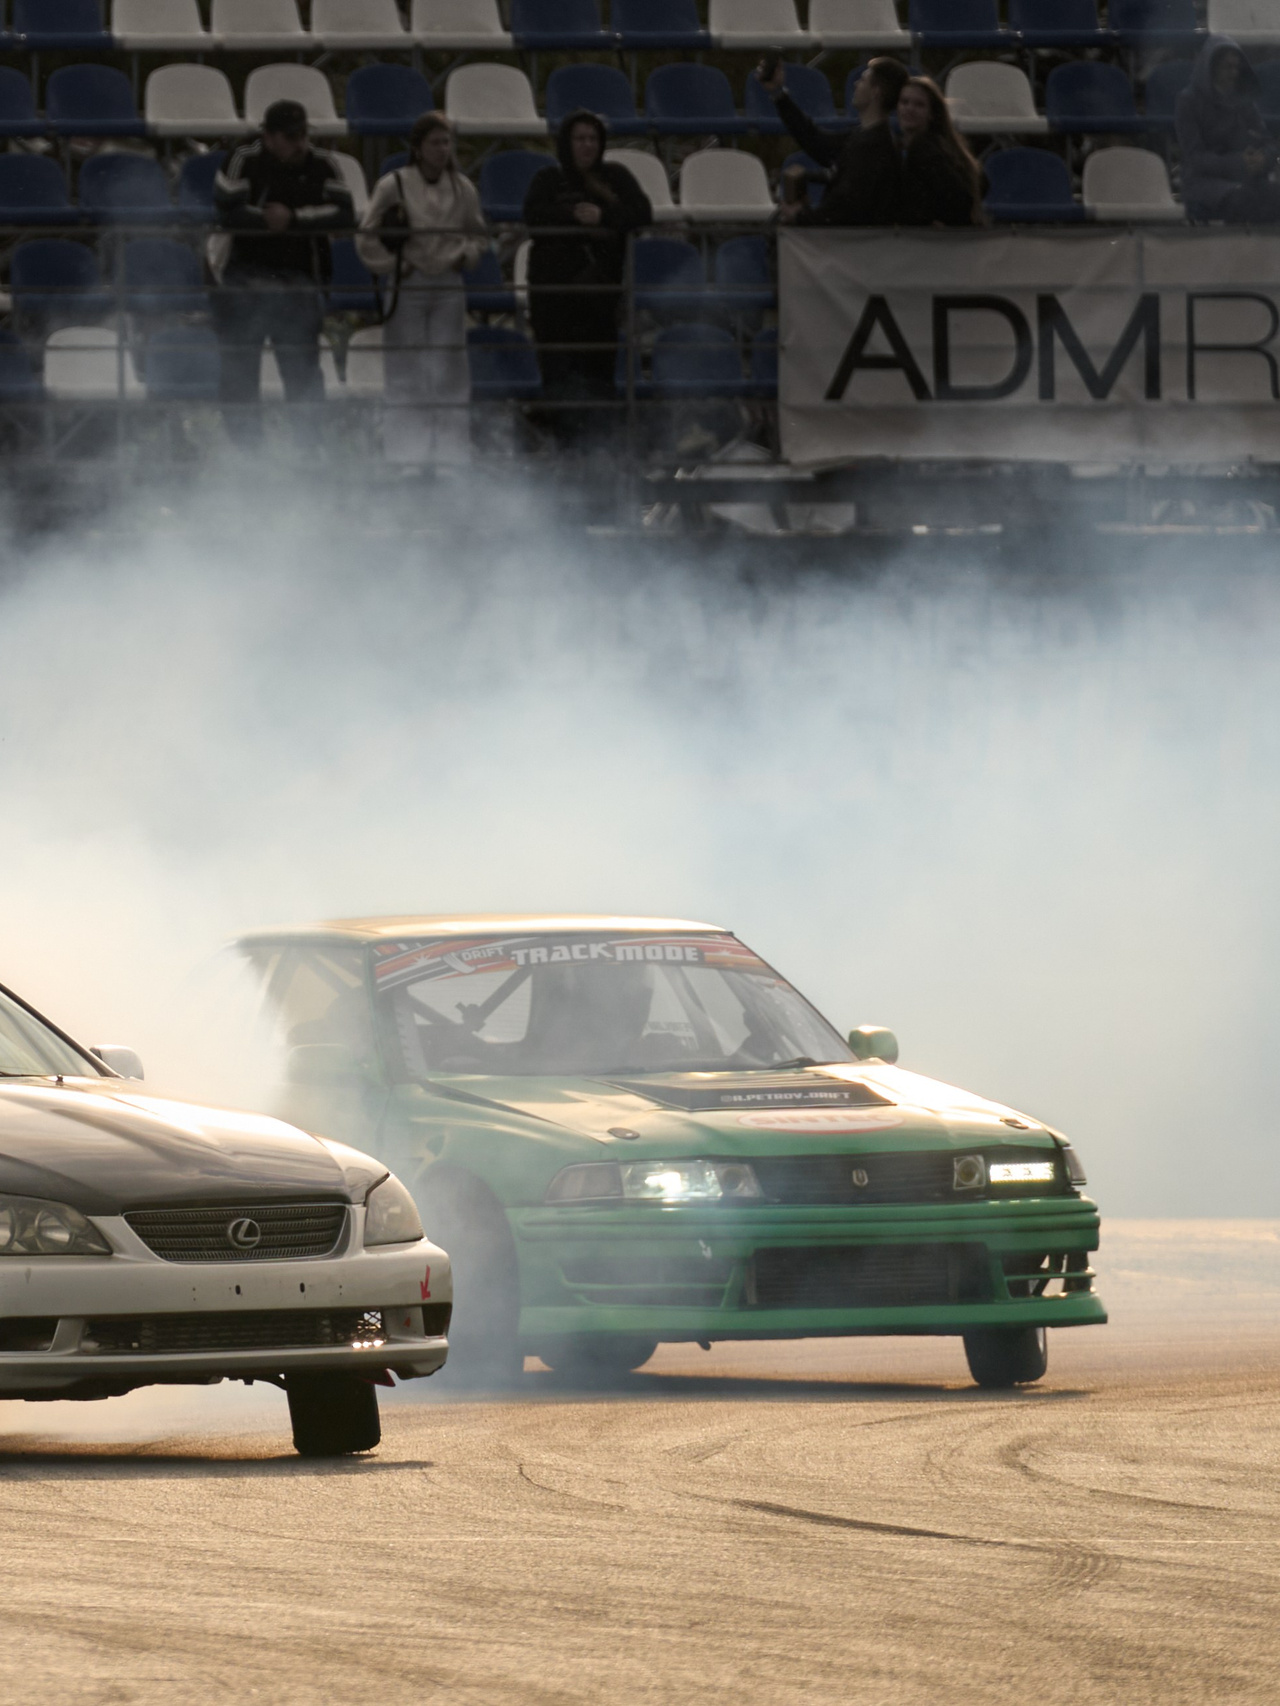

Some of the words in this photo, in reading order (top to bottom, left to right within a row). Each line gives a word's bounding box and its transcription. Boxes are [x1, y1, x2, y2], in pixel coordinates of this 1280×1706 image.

[461, 946, 505, 961] DRIFT
[510, 942, 613, 966] TRACK
[615, 944, 699, 962] MODE
